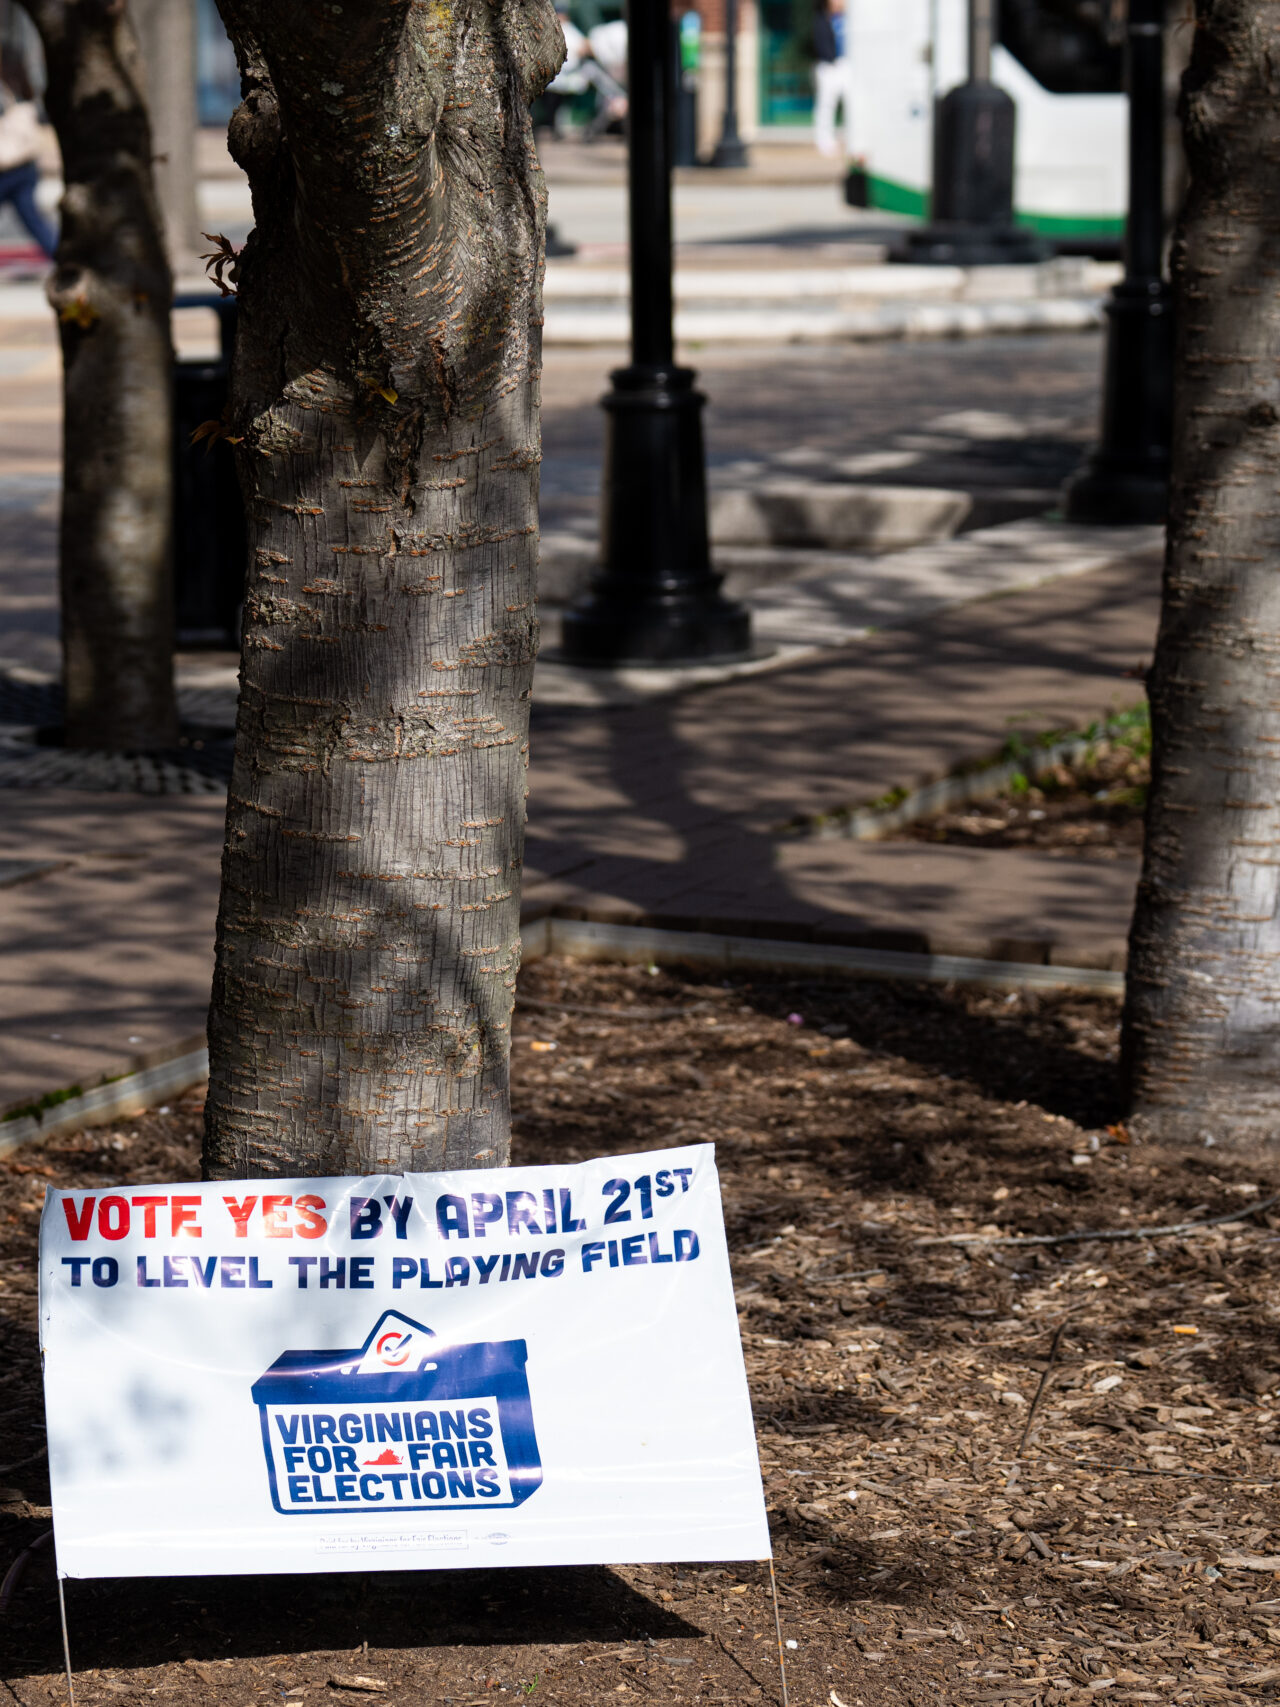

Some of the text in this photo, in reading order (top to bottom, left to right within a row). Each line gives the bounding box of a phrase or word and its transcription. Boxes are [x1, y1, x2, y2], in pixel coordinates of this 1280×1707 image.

[61, 1195, 202, 1241] VOTE
[222, 1194, 328, 1239] YES
[350, 1195, 414, 1240] BY
[435, 1187, 587, 1240] APRIL
[61, 1229, 701, 1289] TO LEVEL THE PLAYING FIELD
[275, 1408, 494, 1445] VIRGINIANS
[283, 1440, 497, 1473] FOR FAIR
[287, 1468, 501, 1503] ELECTIONS
